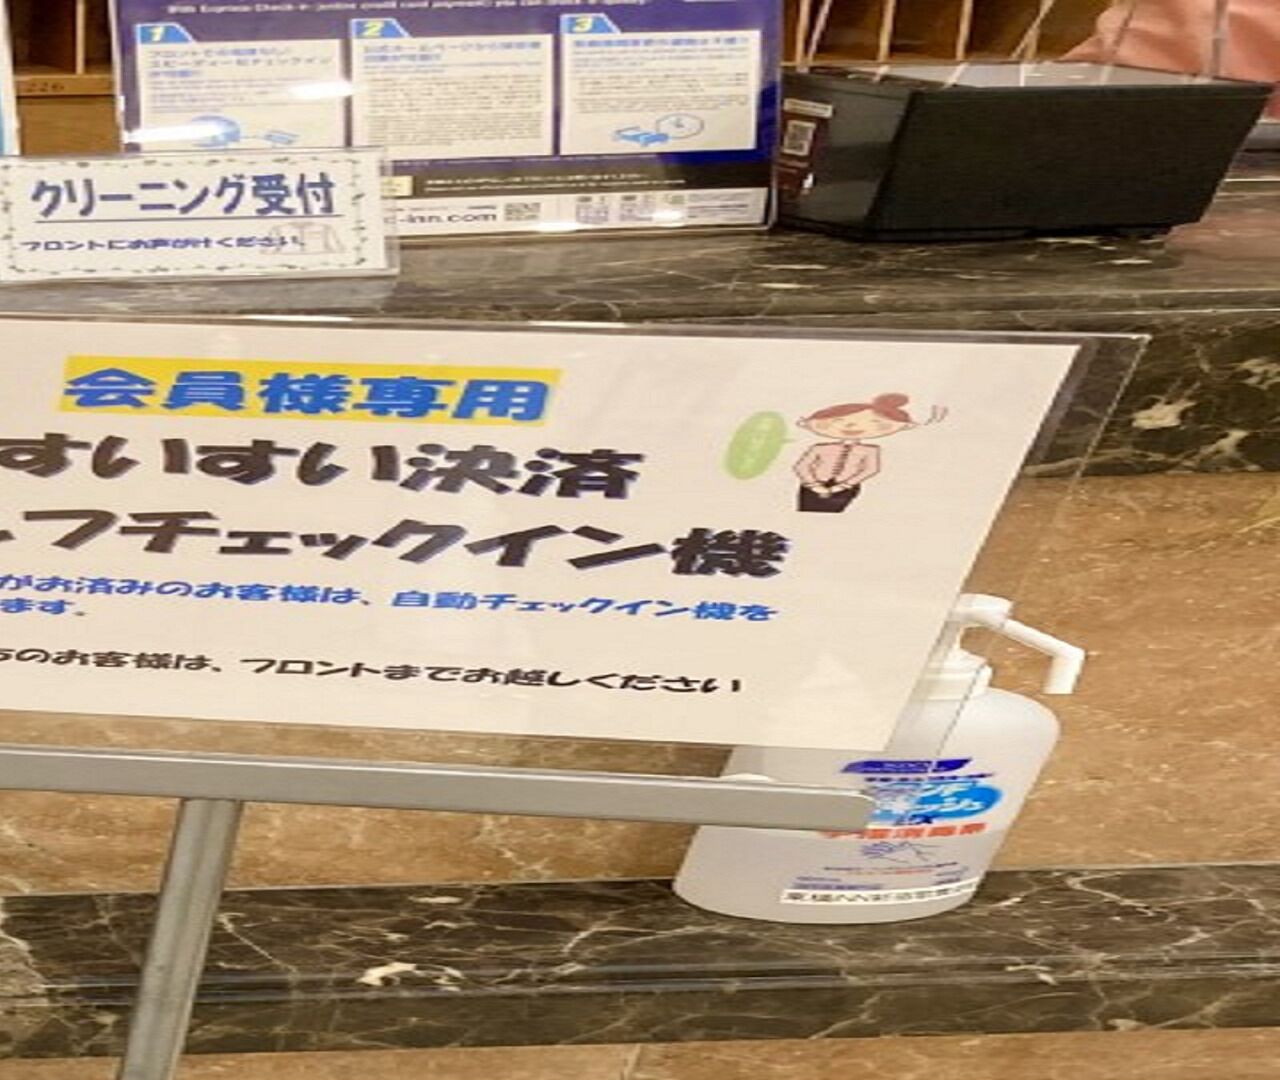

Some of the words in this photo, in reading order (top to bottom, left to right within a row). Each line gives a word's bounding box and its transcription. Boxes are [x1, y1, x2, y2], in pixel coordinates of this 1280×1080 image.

[361, 20, 385, 37] 2
[572, 15, 594, 32] 3
[149, 26, 166, 42] 1
[31, 171, 335, 217] クリーニング受付
[63, 367, 551, 421] 会員様専用
